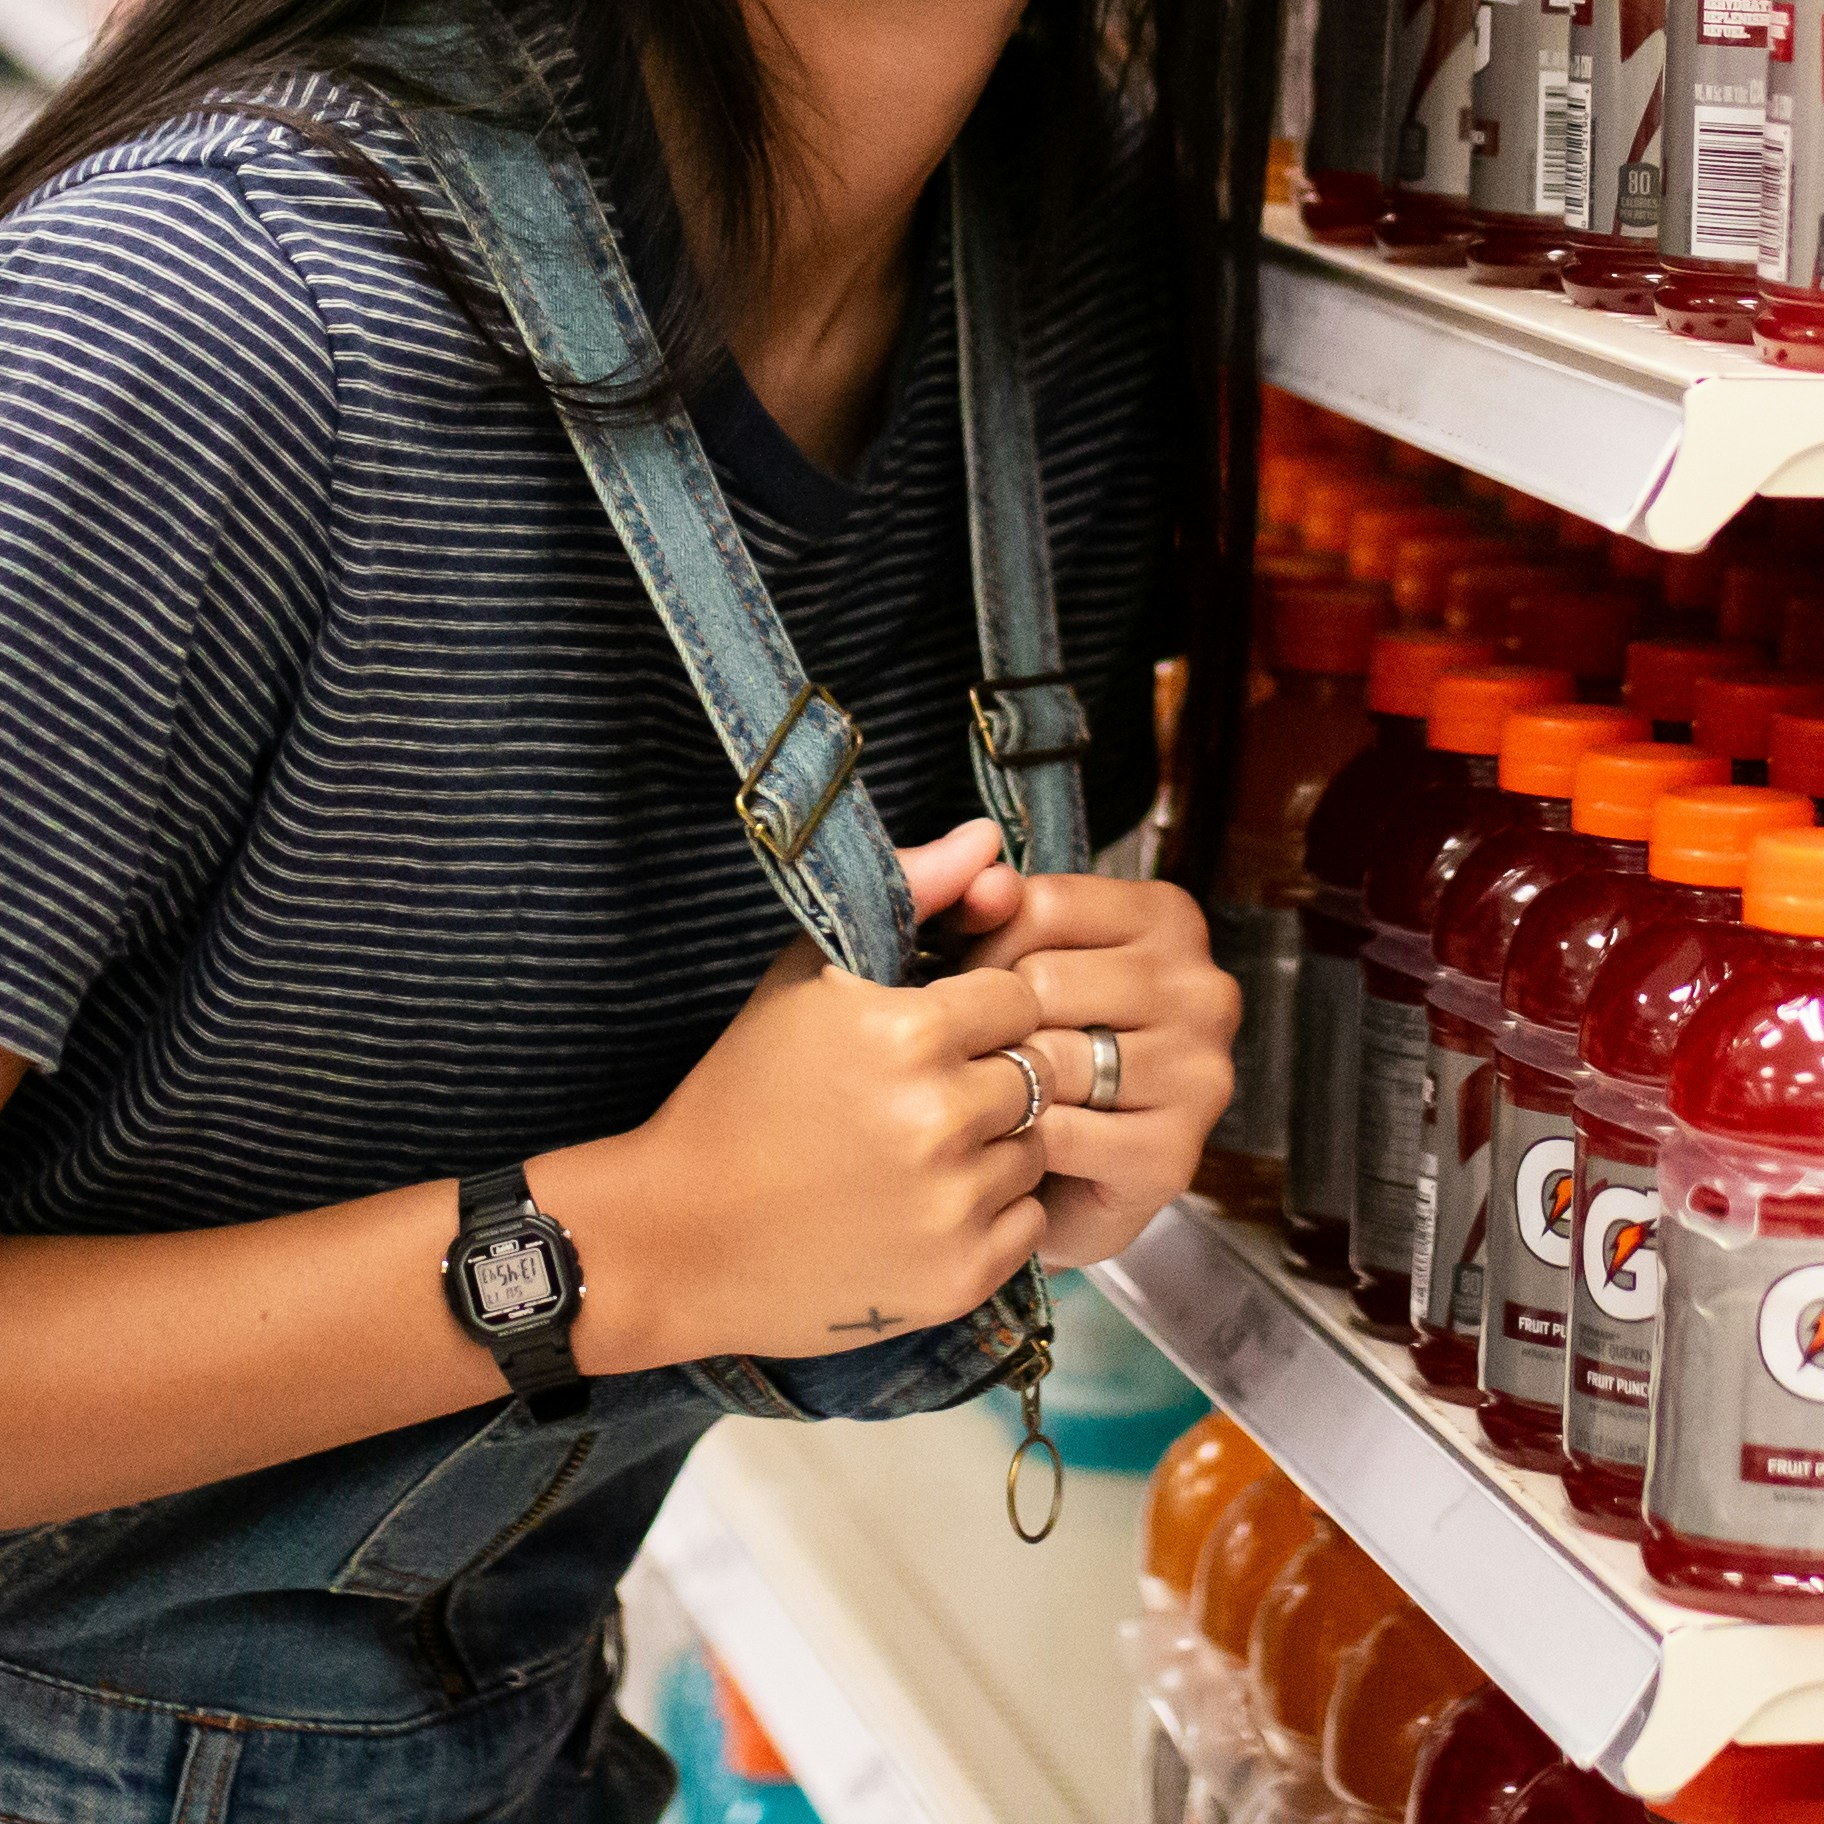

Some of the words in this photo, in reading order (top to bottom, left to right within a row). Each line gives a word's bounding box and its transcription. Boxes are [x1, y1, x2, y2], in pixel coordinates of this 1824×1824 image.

[1628, 171, 1650, 195] 80
[1583, 1185, 1667, 1322] G
[1518, 1316, 1549, 1336] FRUIT
[1587, 1370, 1614, 1390] FRUIT
[1617, 1375, 1648, 1396] PUNC
[1767, 1458, 1811, 1475] FRUIT
